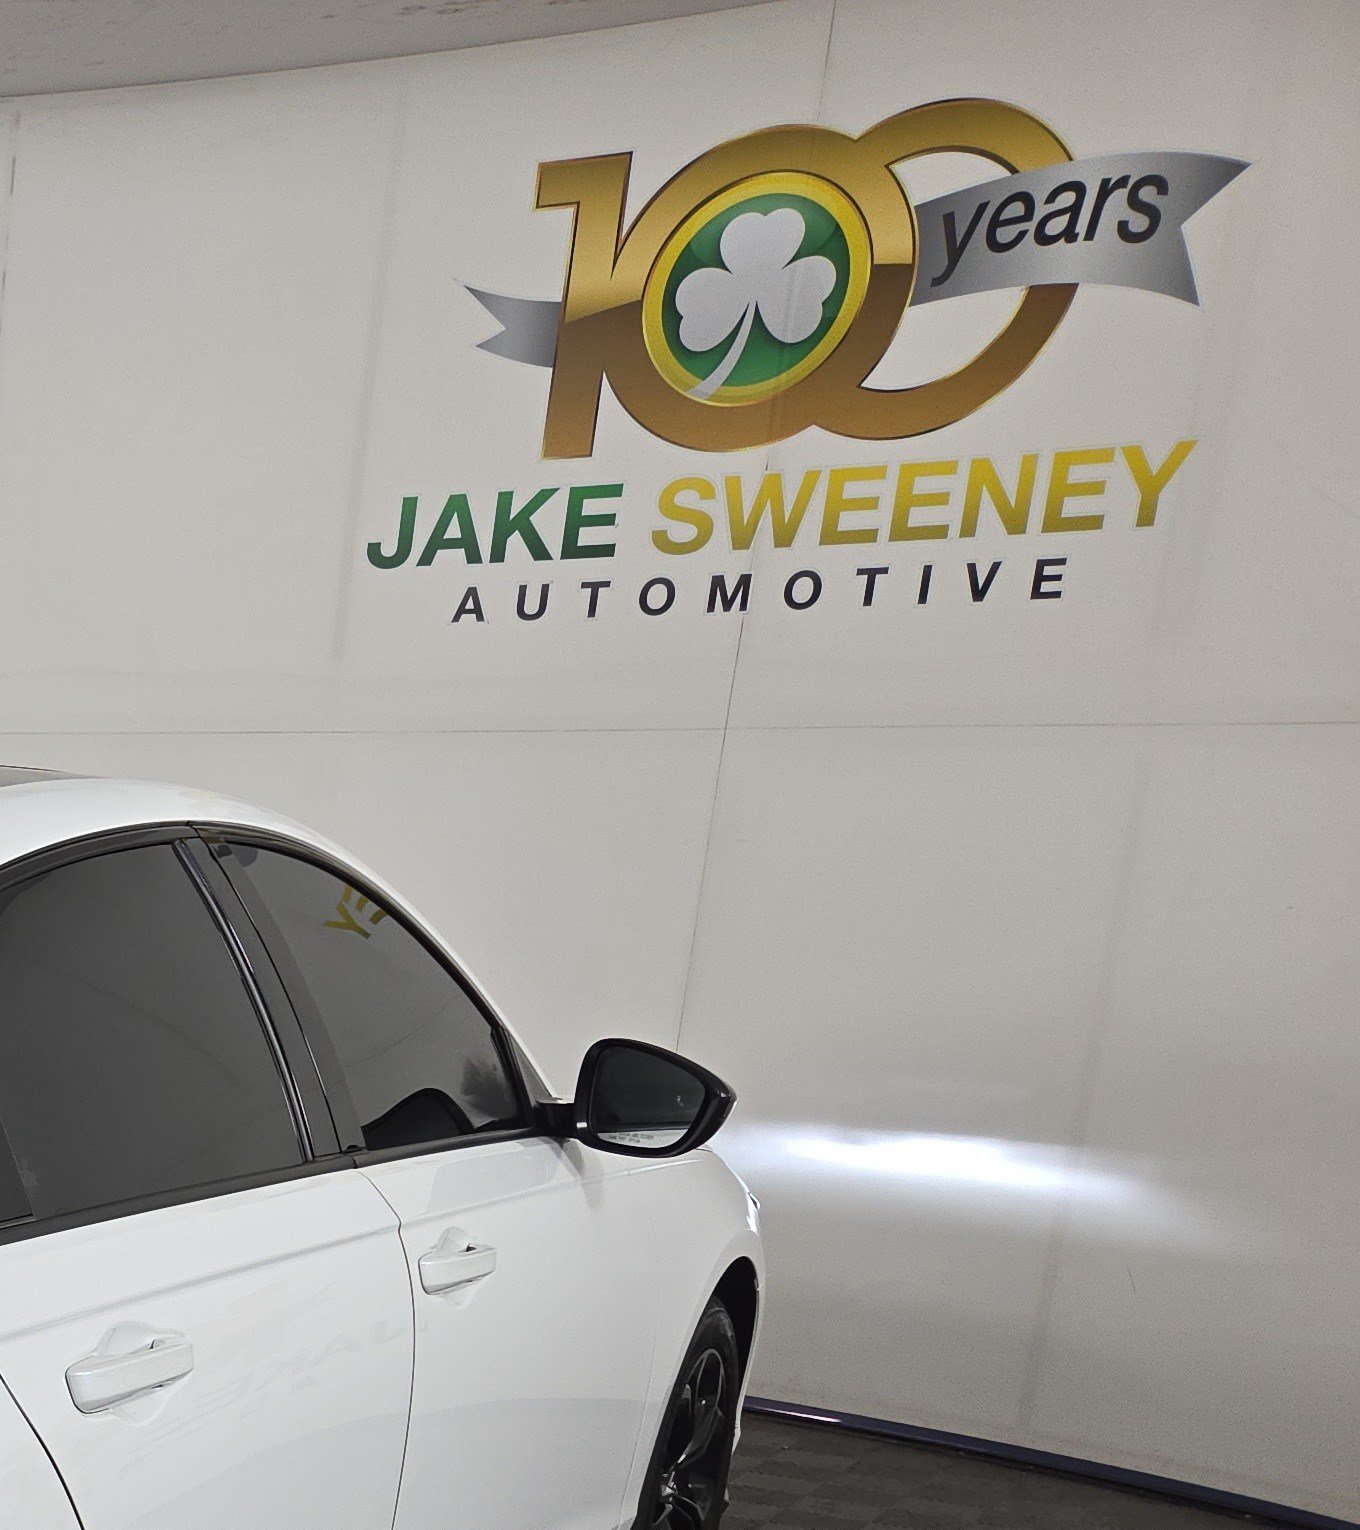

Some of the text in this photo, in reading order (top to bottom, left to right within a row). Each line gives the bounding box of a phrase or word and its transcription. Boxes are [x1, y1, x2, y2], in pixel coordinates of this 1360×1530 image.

[534, 97, 1170, 461] 100 years
[366, 438, 1199, 571] JAKE SWEENEY
[451, 557, 1068, 624] AUTOMOTIVE
